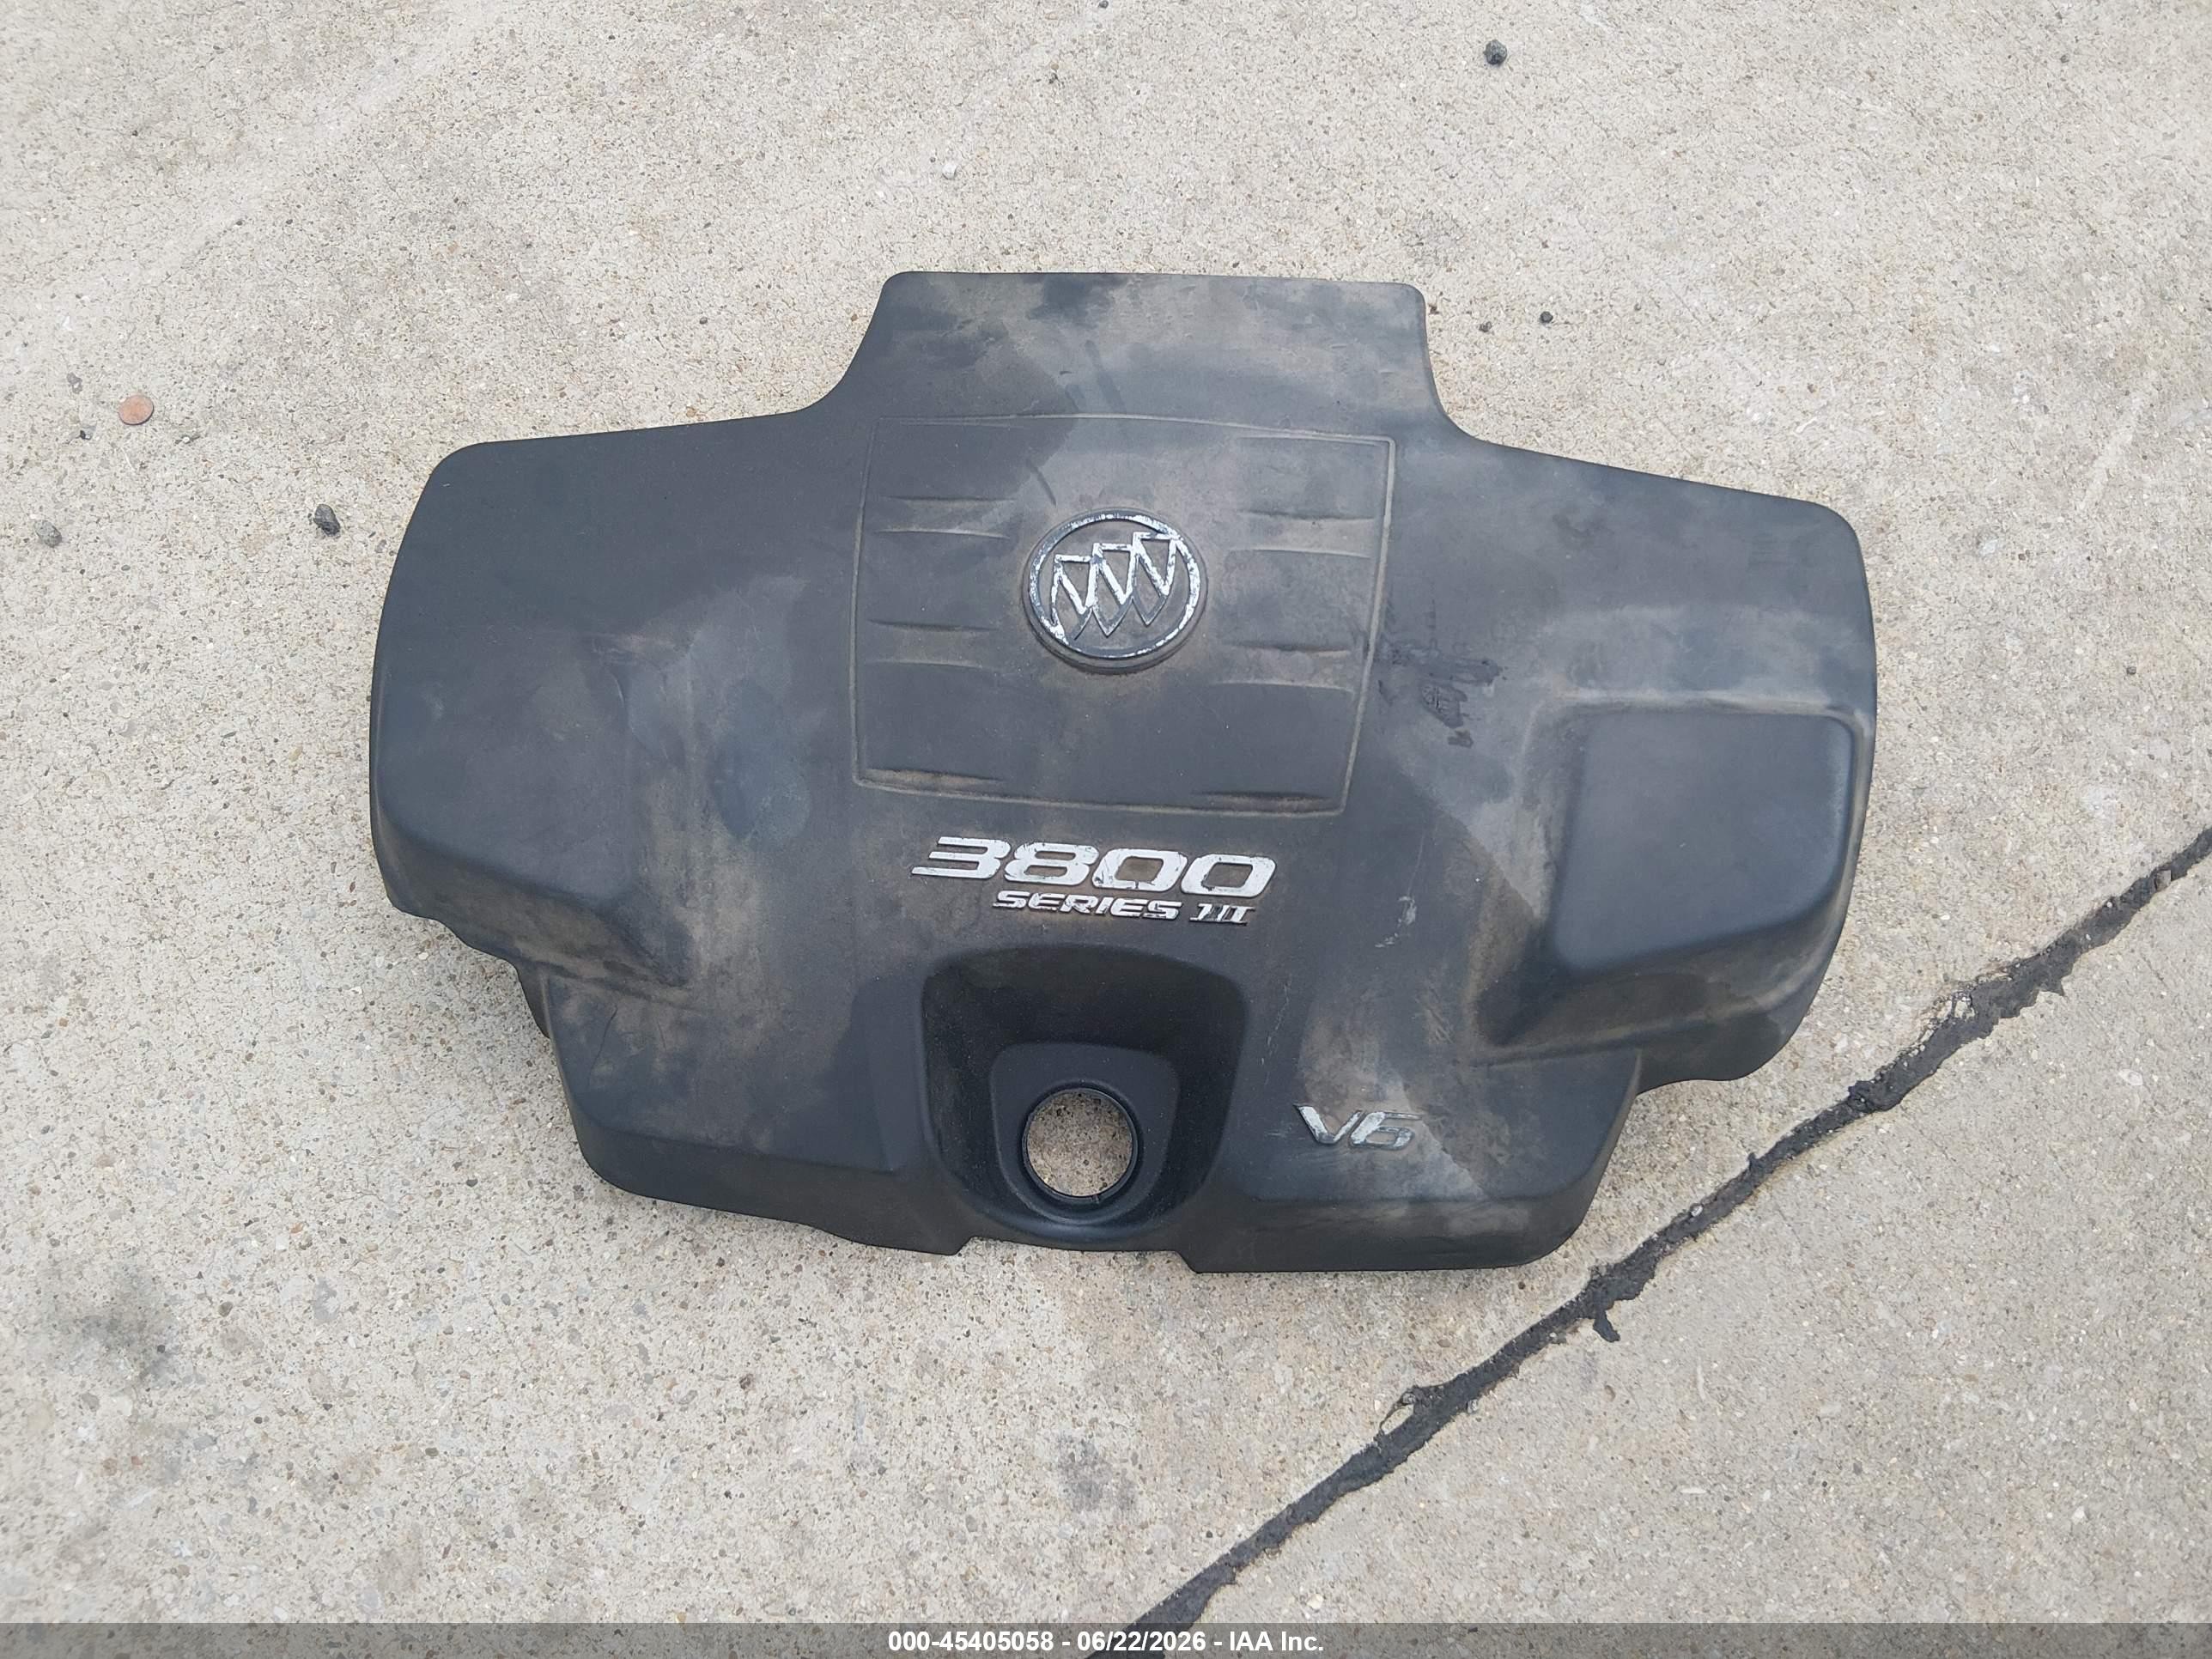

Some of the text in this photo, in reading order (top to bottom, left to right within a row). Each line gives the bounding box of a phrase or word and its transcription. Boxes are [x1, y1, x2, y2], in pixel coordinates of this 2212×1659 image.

[911, 836, 1277, 897] 3800
[992, 890, 1256, 927] SERIES III
[1292, 1103, 1423, 1151] V6
